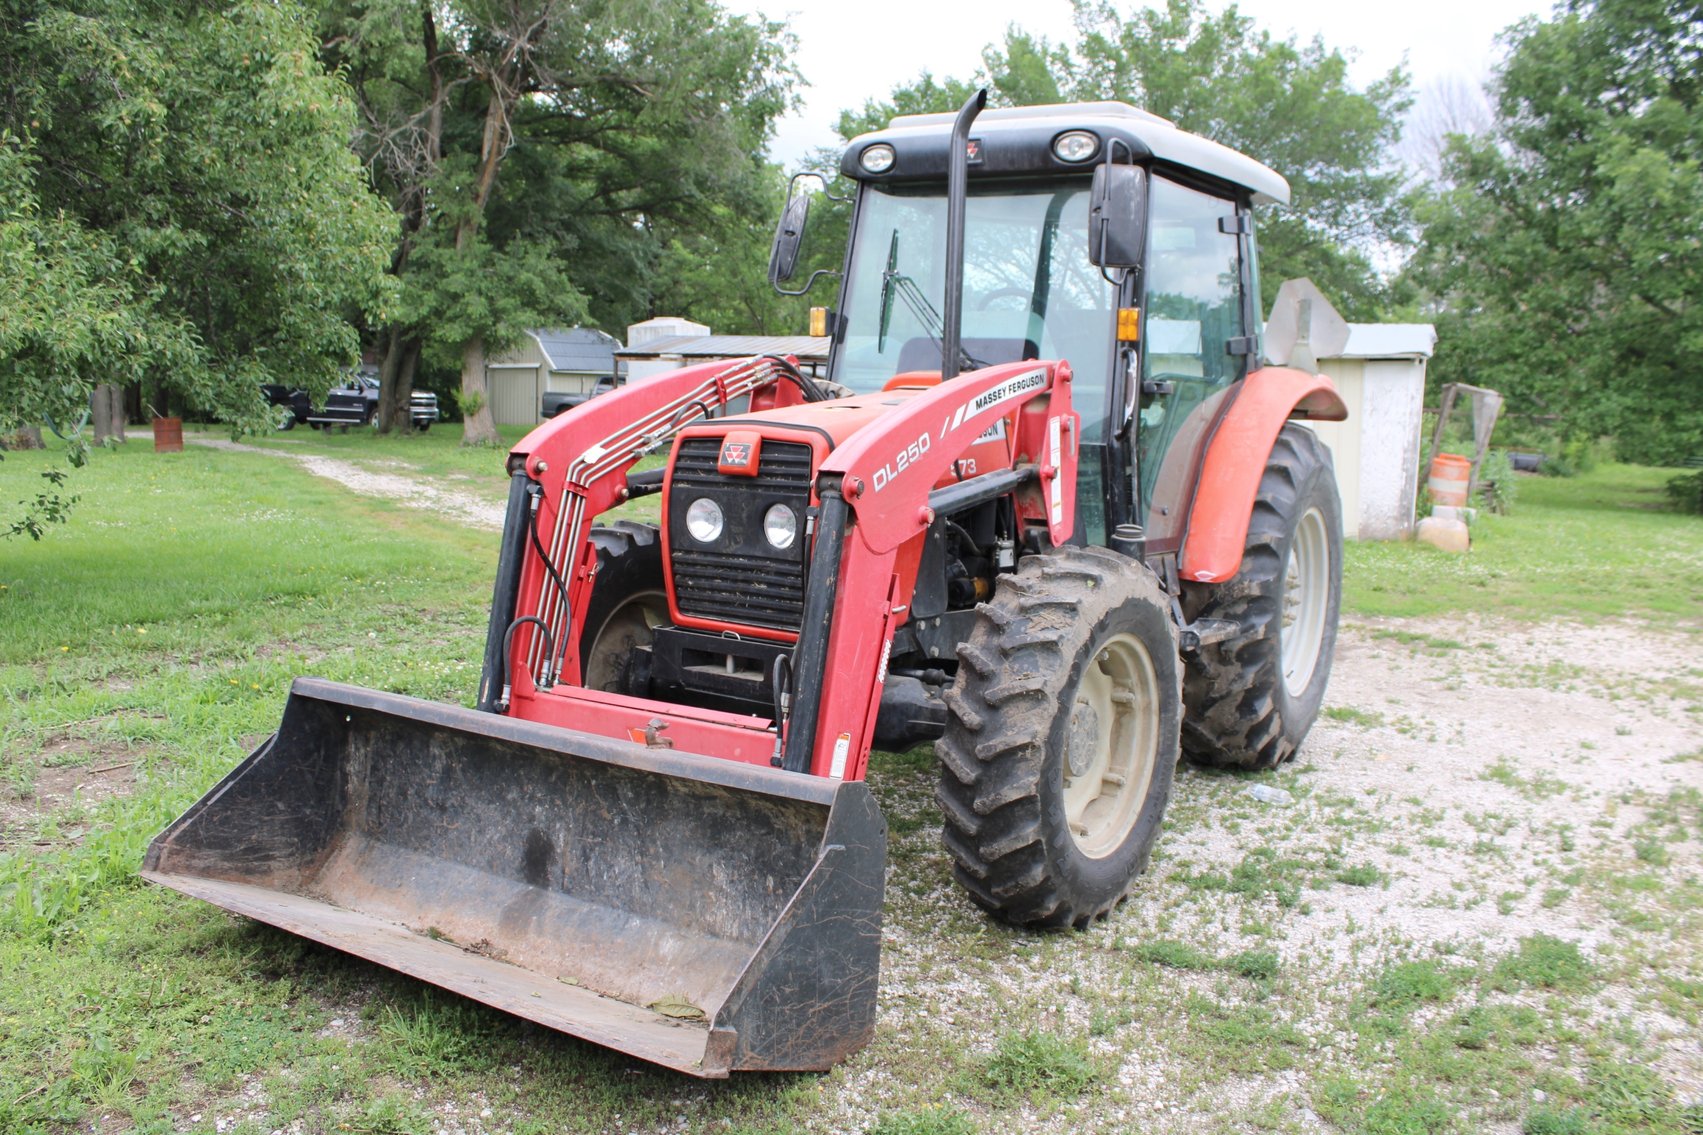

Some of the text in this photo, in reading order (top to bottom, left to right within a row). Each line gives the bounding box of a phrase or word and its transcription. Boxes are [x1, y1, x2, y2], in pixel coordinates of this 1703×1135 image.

[975, 374, 1045, 411] MASSEY FERGUSON
[872, 431, 931, 493] DL250
